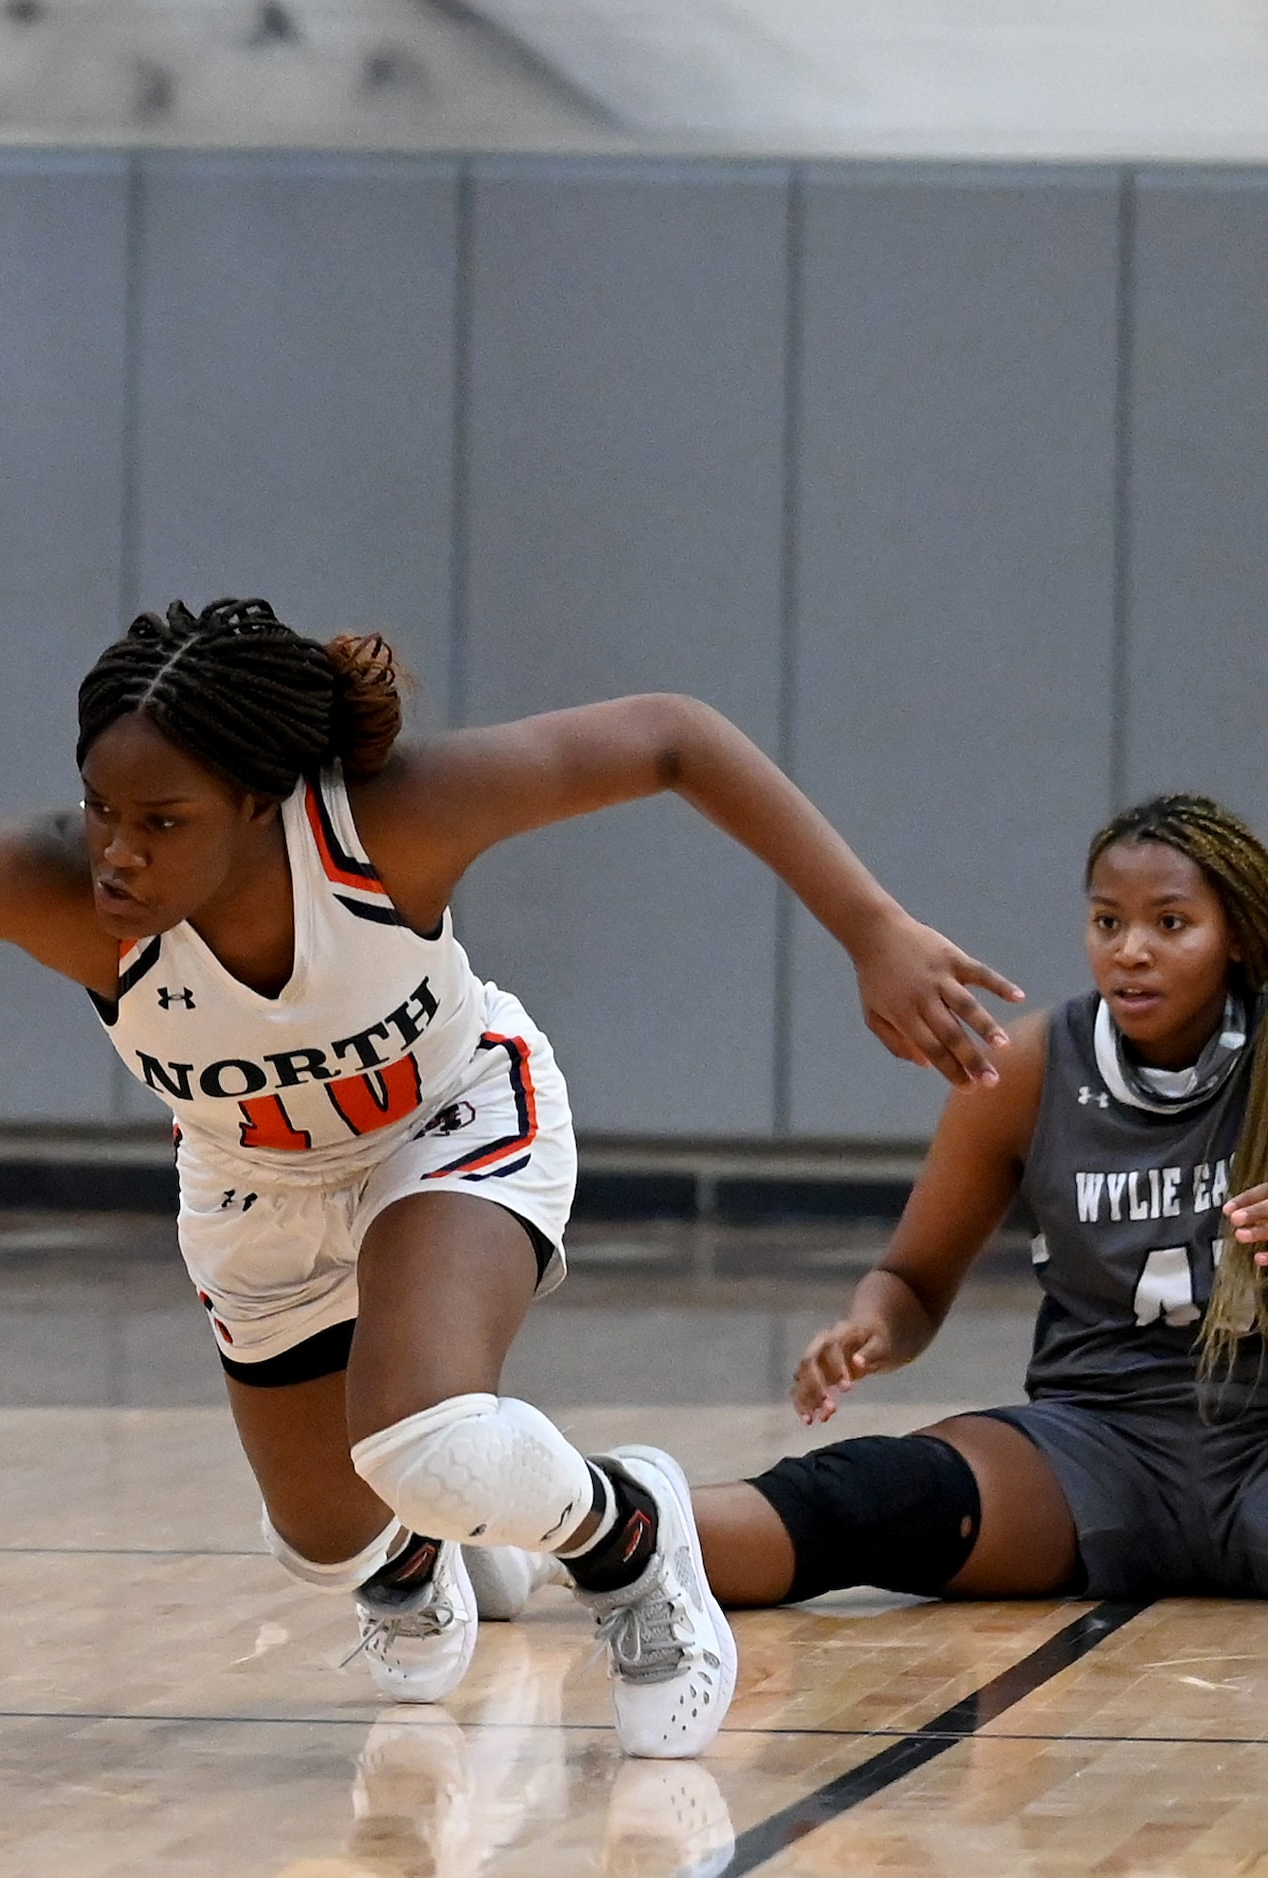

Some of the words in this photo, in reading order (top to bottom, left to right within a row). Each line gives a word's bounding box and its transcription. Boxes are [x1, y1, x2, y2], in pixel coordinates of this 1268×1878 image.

[134, 975, 440, 1101] NORTH
[237, 1051, 422, 1151] 10
[1074, 1166, 1182, 1223] WYLIE
[1192, 1150, 1237, 1214] EA
